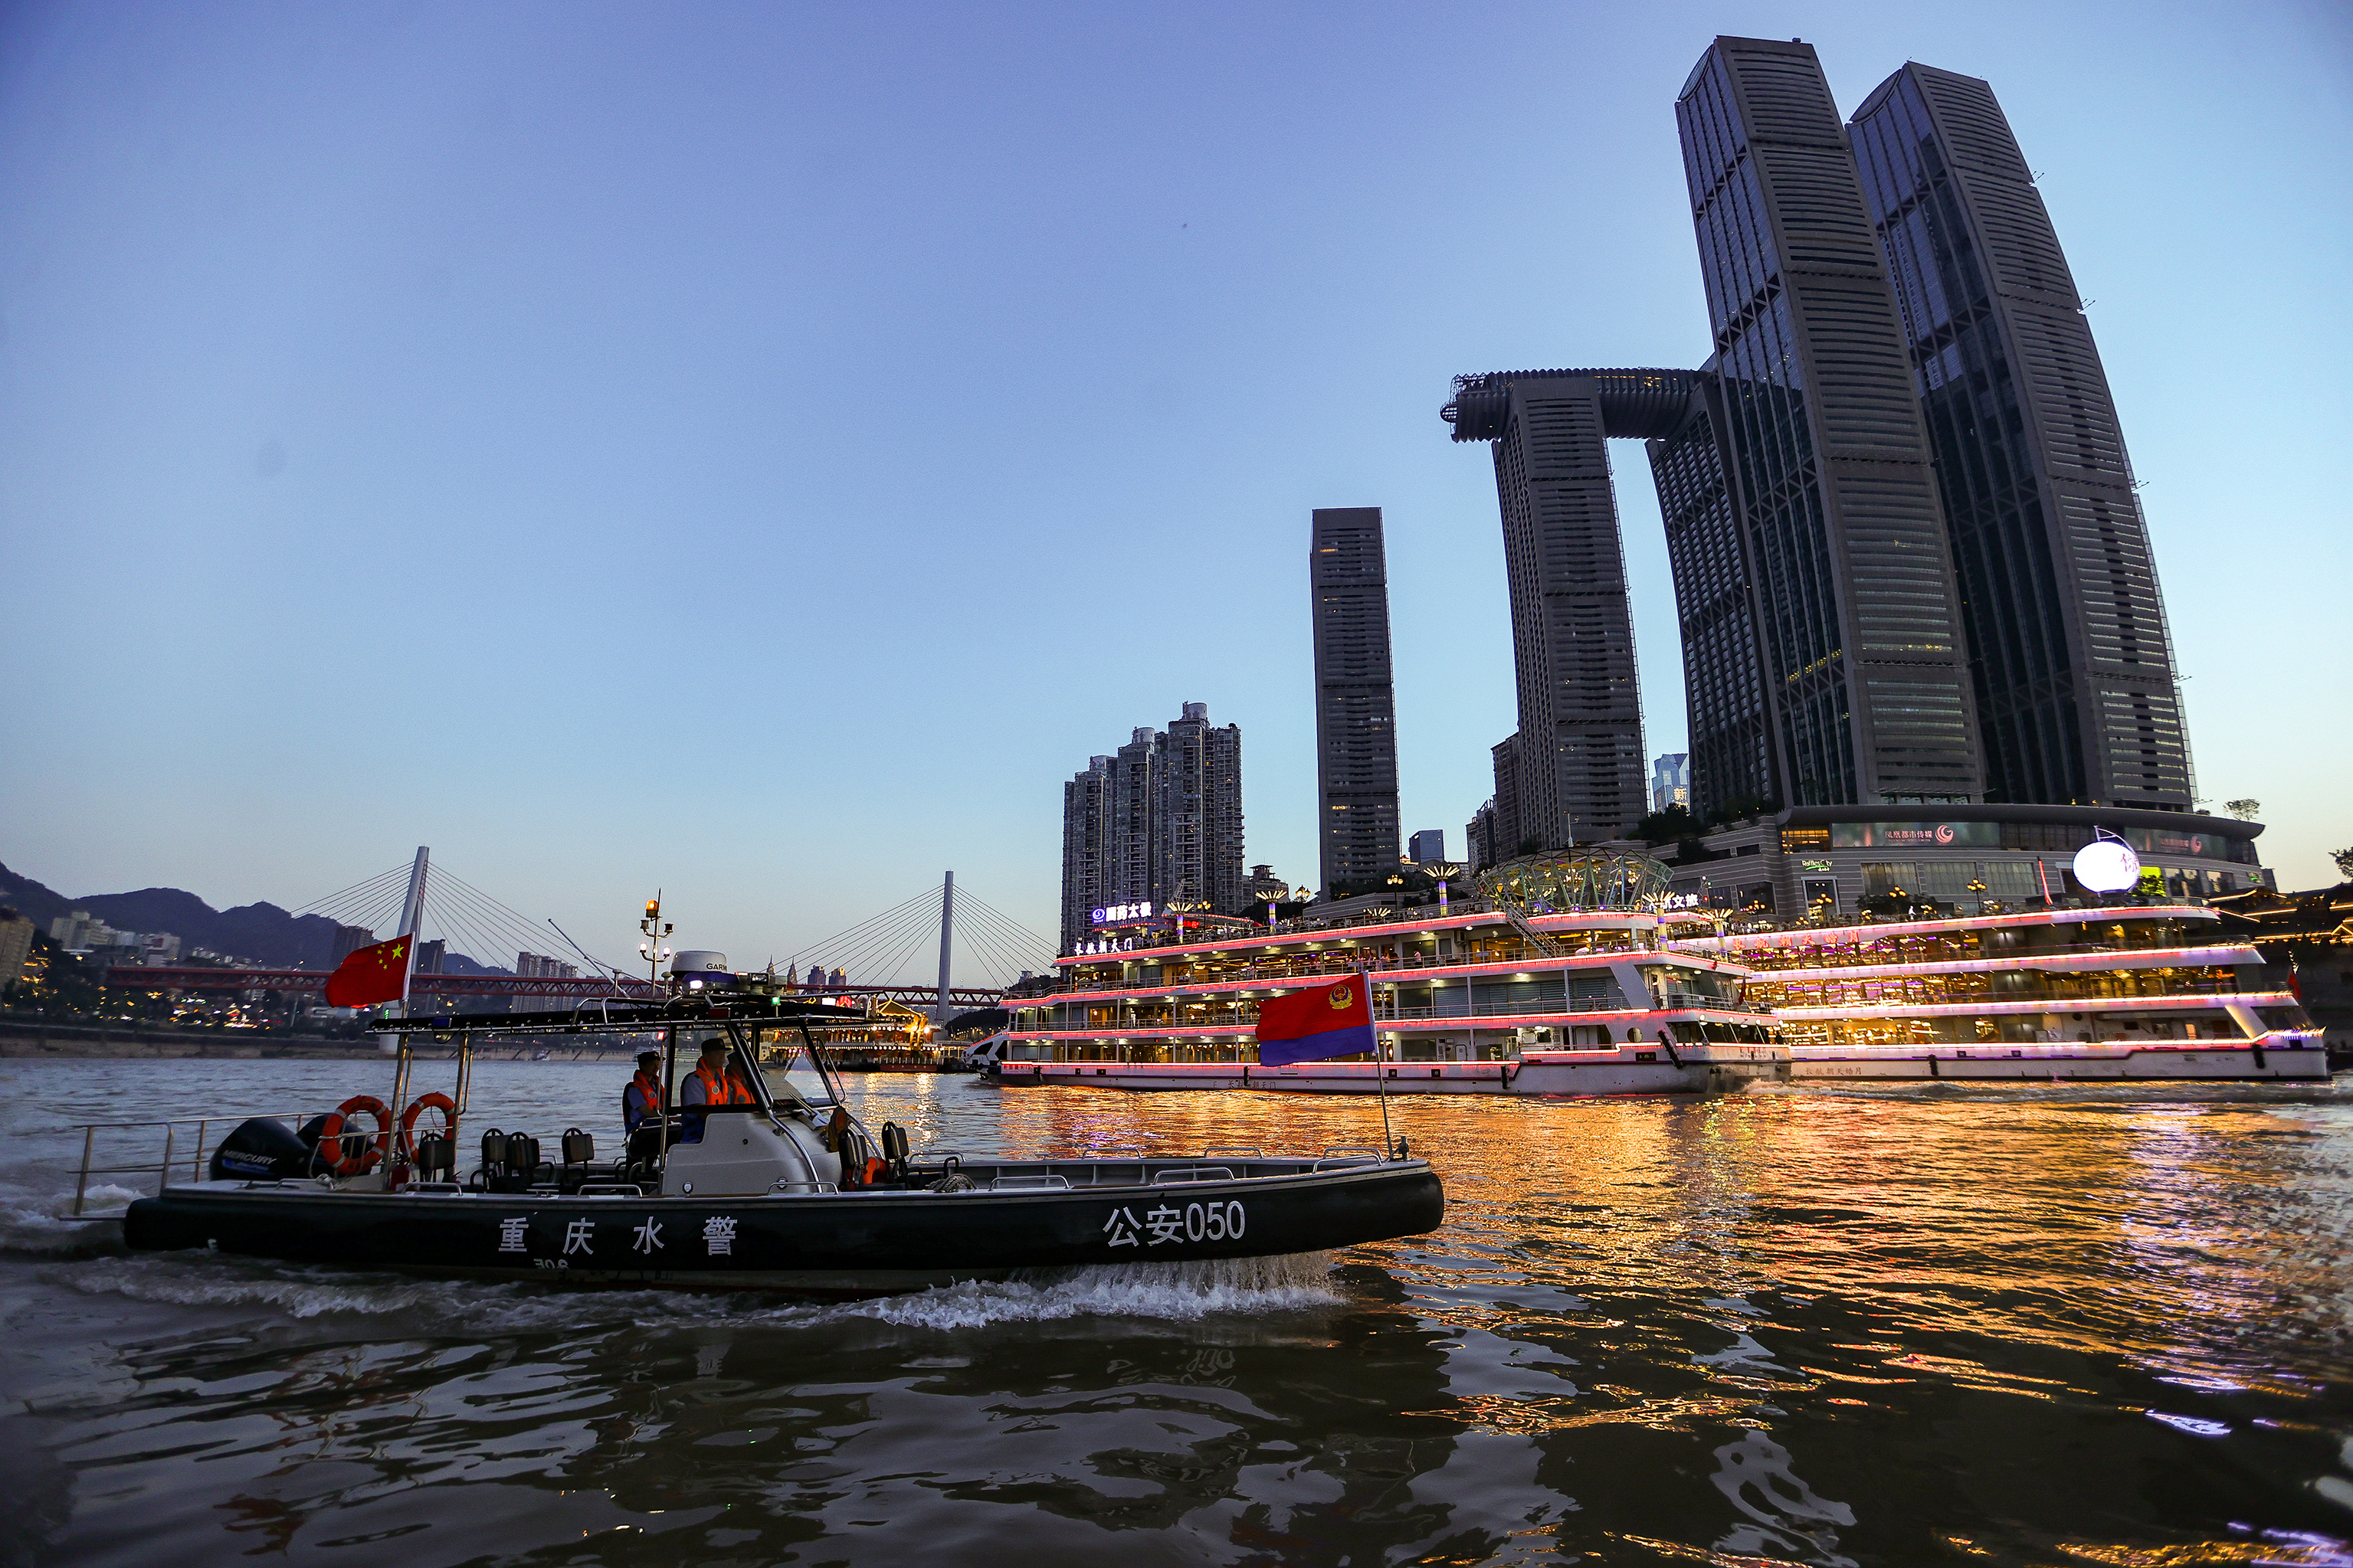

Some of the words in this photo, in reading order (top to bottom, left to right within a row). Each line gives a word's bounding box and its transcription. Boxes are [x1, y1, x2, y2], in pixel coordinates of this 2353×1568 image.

[1885, 830, 1933, 839] 凤凰都市传媒
[222, 1149, 277, 1165] MERCURY
[499, 1216, 738, 1255] 重庆水警
[1103, 1200, 1246, 1247] 公安050
